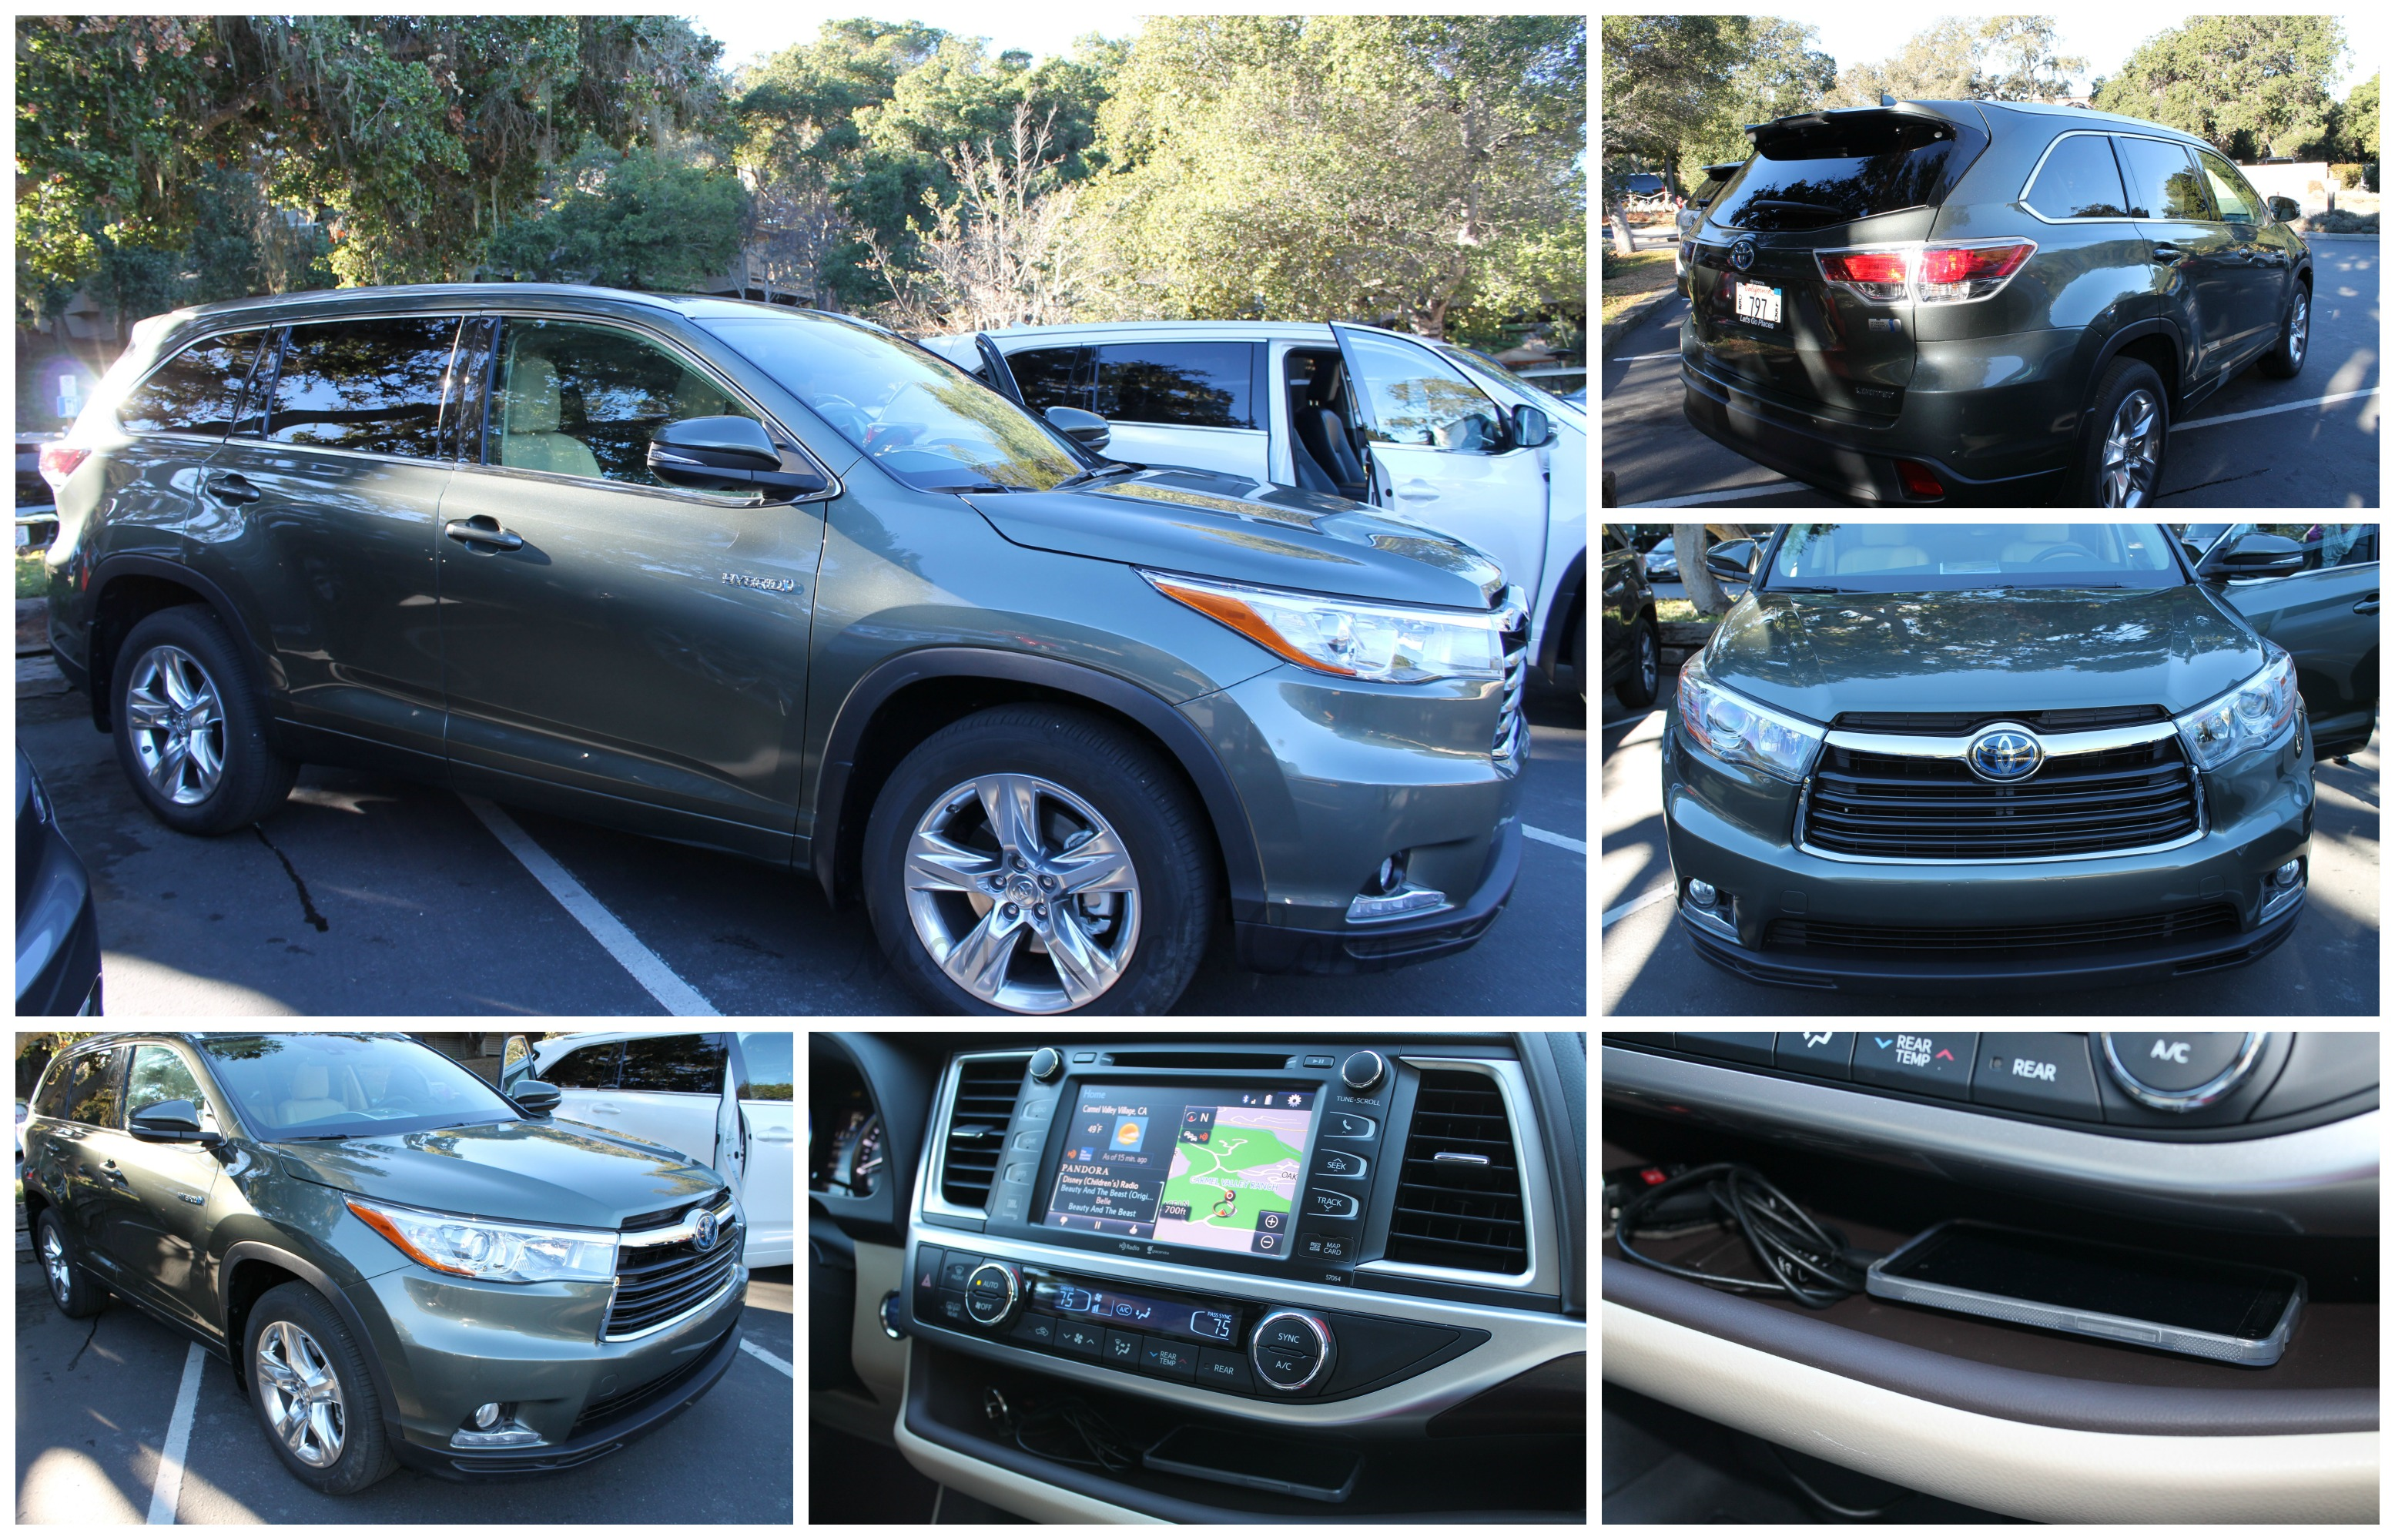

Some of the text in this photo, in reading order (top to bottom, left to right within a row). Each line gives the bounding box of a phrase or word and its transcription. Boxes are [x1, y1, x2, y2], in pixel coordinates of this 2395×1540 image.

[1749, 296, 1767, 320] 797
[1740, 315, 1774, 329] Let's Go Places
[1897, 1034, 1932, 1053] REAR
[2150, 1039, 2191, 1063] A/C
[1895, 1049, 1931, 1066] TEMP
[2012, 1058, 2057, 1082] REAR
[1083, 1089, 1106, 1099] Home
[1082, 1105, 1147, 1116] Carmel Valley Village, CA
[1200, 1113, 1209, 1123] N
[1061, 1163, 1109, 1176] PANDORA
[1326, 1161, 1347, 1170] SEEK
[1281, 1171, 1298, 1180] OAK
[1062, 1175, 1139, 1190] Disney (Children's) Radio
[1190, 1176, 1278, 1191] CARMEL VALLEY RANCH
[1060, 1184, 1082, 1194] Beauty
[1082, 1186, 1095, 1195] And
[1097, 1187, 1108, 1196] The
[1110, 1189, 1127, 1198] Beast
[1096, 1197, 1111, 1205] Belle
[1317, 1197, 1342, 1207] TRACK
[1068, 1203, 1137, 1217] Beauty And The Beast
[1164, 1205, 1187, 1215] 700ft
[1323, 1247, 1342, 1256] CARD
[983, 1281, 999, 1289] AUTO
[1060, 1291, 1074, 1307] 75
[980, 1303, 993, 1311] OFF
[1214, 1318, 1230, 1337] 75
[1278, 1332, 1300, 1344] SYNC
[1160, 1351, 1177, 1360] REAR
[1159, 1358, 1176, 1367] TEMP
[1275, 1361, 1291, 1371] A/C
[1214, 1364, 1234, 1375] REAR
